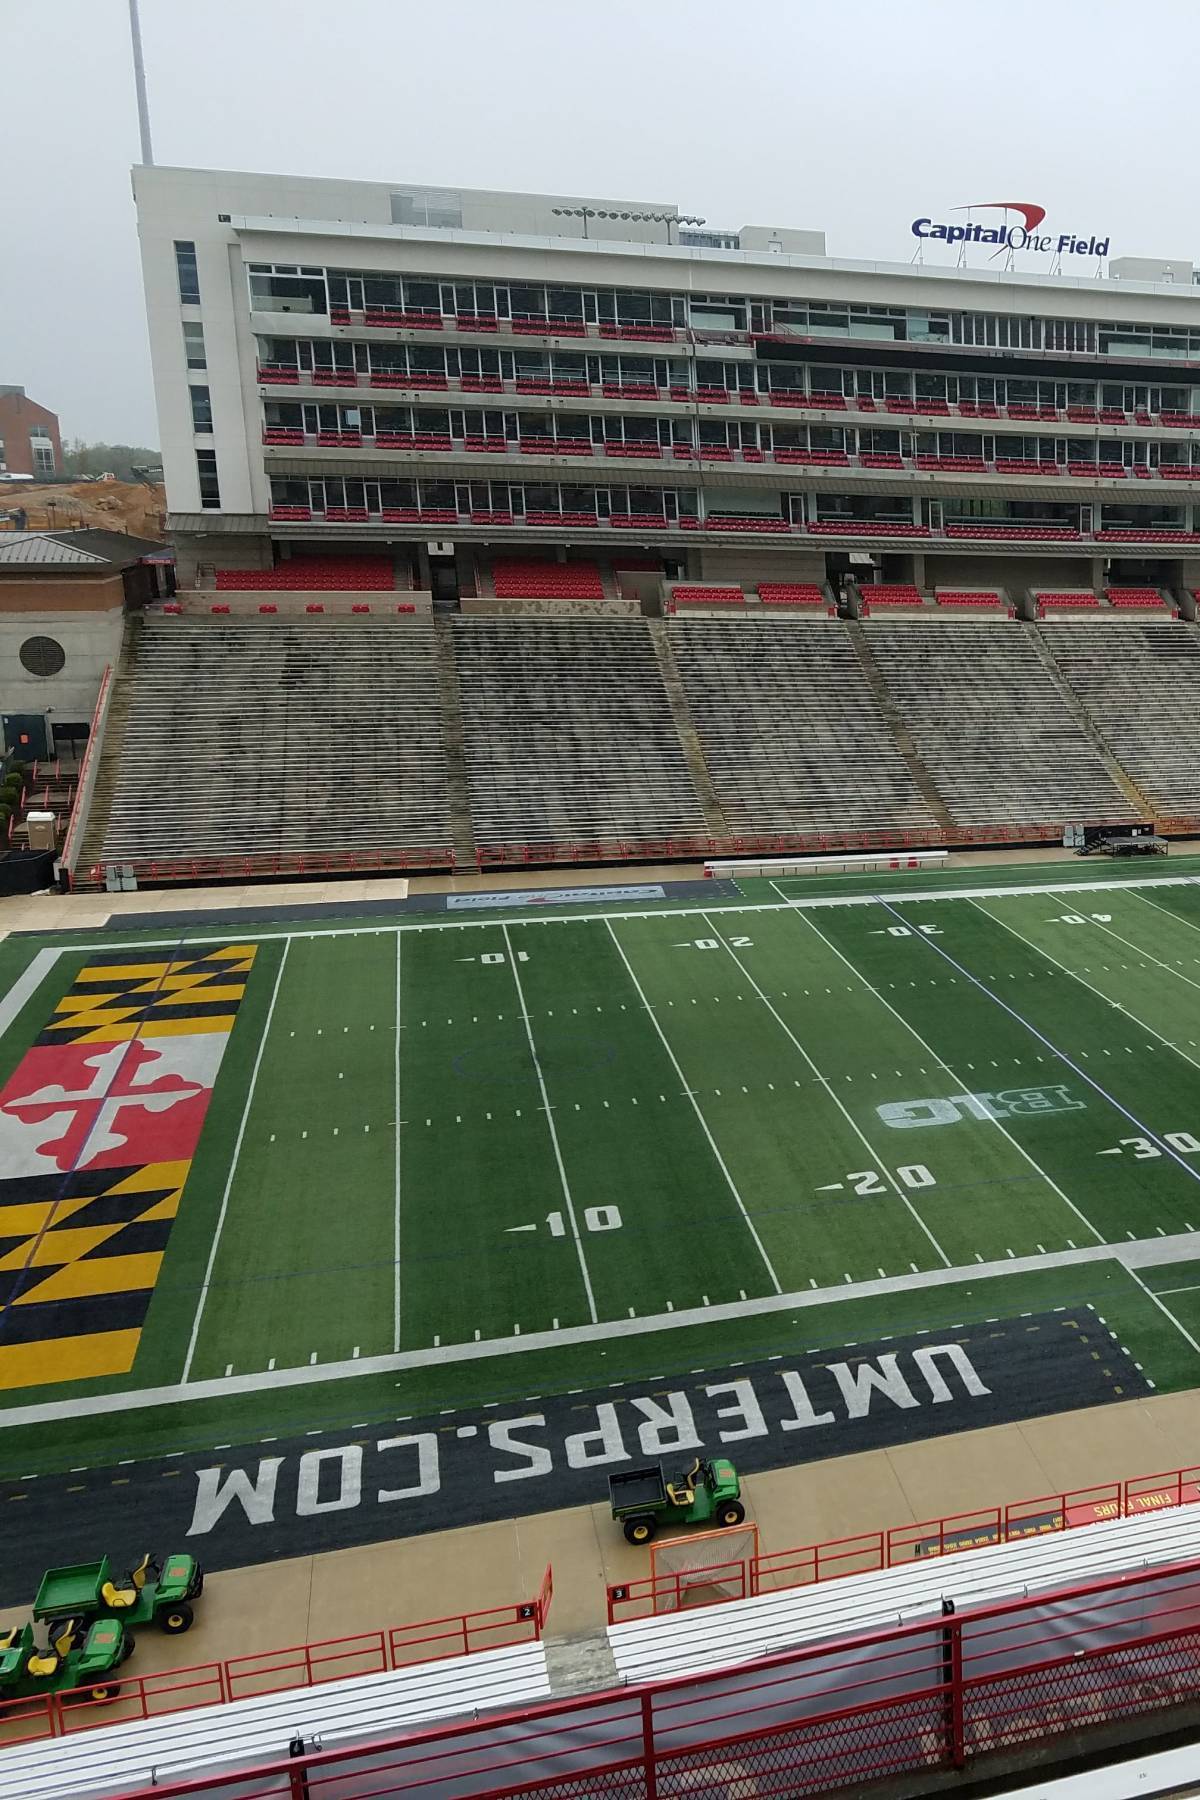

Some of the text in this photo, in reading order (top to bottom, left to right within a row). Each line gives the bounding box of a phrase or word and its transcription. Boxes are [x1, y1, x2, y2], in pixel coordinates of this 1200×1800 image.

[911, 218, 1110, 257] Capital One Field
[846, 1164, 936, 1195] 20
[545, 1205, 623, 1236] 10
[184, 1343, 993, 1536] UMTERPS.COM
[1135, 1493, 1172, 1508] FINAL
